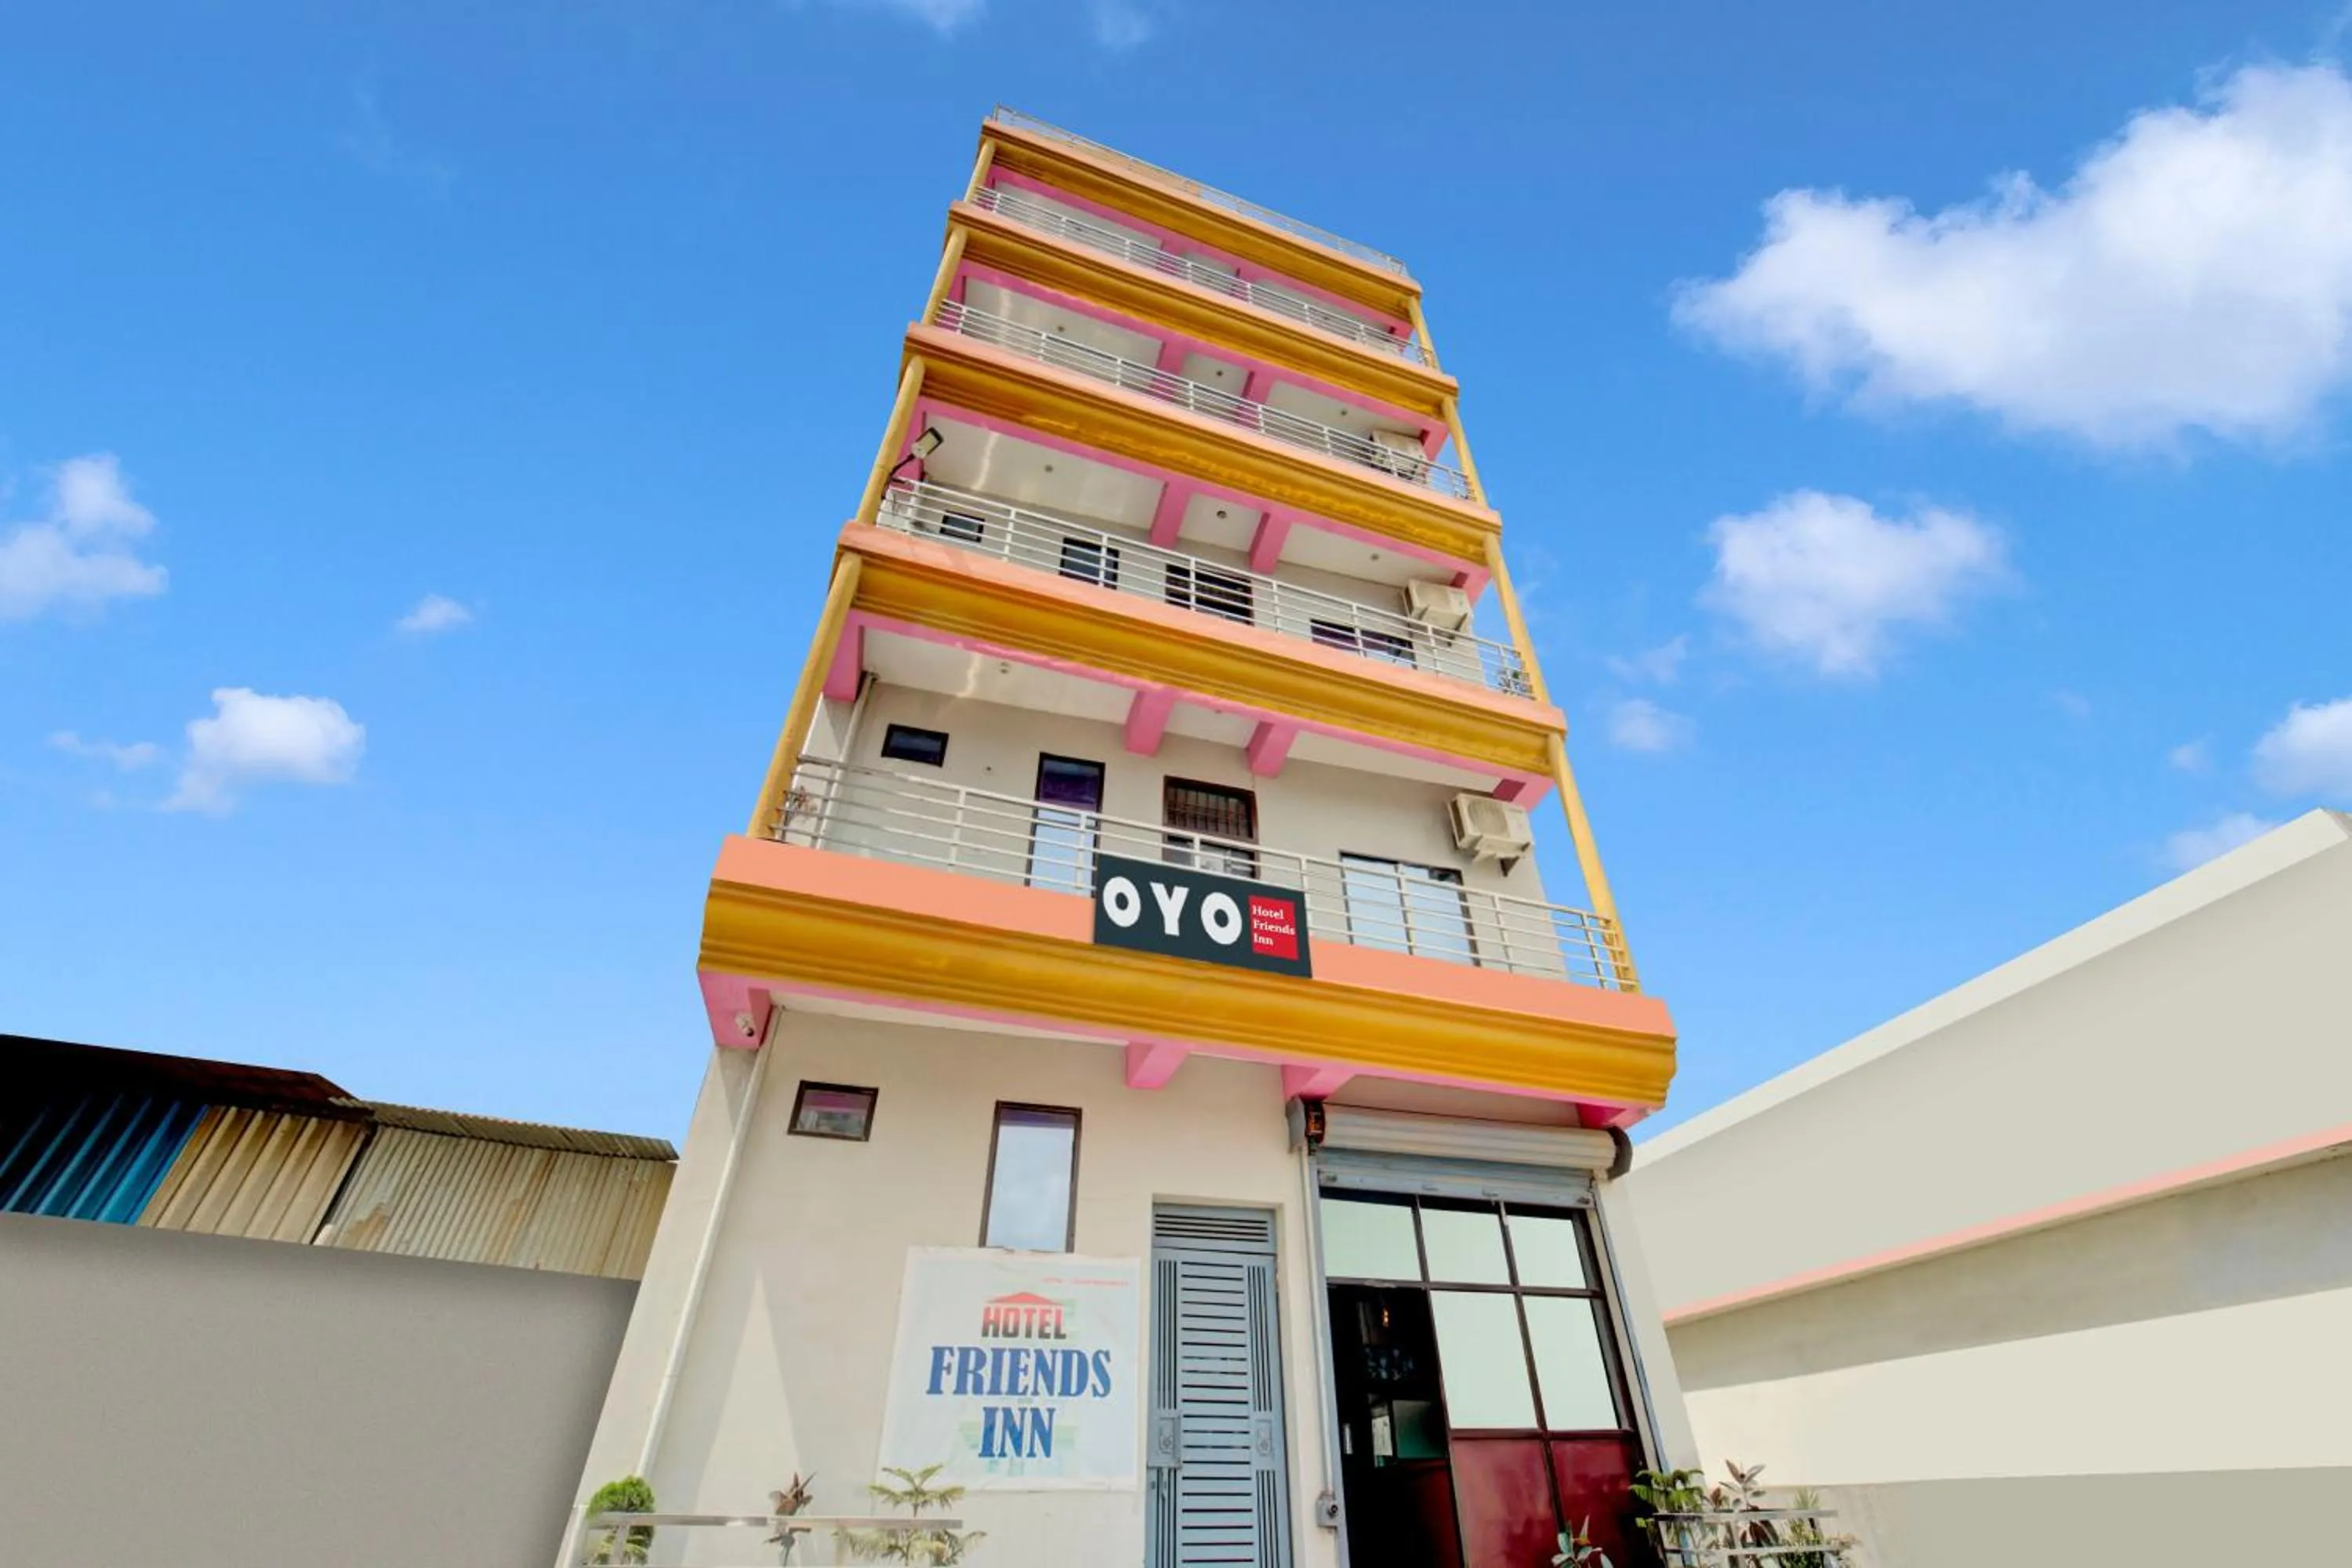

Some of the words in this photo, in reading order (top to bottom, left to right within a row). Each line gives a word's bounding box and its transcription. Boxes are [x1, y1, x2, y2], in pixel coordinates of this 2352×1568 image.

[1103, 876, 1242, 945] OYO
[1252, 904, 1283, 920] Hotel
[1254, 919, 1296, 935] Friends
[1254, 932, 1274, 946] Inn
[982, 1306, 1066, 1339] HOTEL
[926, 1346, 1112, 1398] FRIENDS
[978, 1406, 1056, 1458] INN
